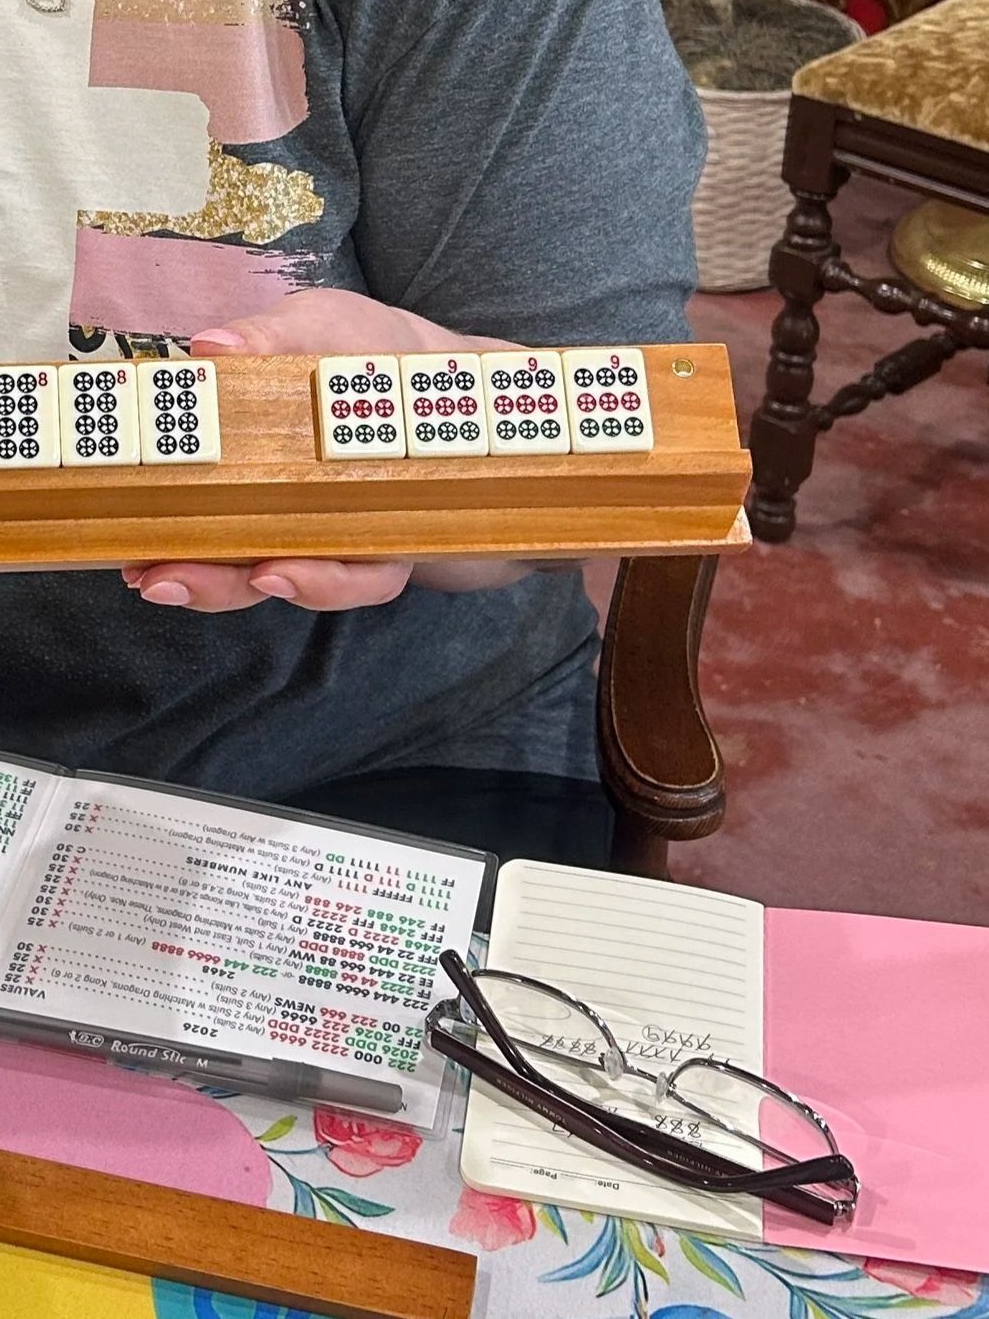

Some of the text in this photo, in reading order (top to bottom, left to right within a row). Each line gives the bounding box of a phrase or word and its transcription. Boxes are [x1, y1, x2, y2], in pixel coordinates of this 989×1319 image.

[365, 361, 375, 376] 9
[447, 359, 458, 374] 9
[528, 357, 538, 372] 9
[610, 355, 620, 370] 9
[38, 372, 48, 386] 8
[117, 370, 127, 384] 8
[196, 368, 206, 382] 8
[63, 821, 82, 832] 30
[55, 841, 74, 853] 30
[184, 855, 312, 890] ANY LIKE NUMBERS
[336, 879, 368, 893] 1111
[303, 894, 330, 908] 888
[371, 886, 413, 903] FFFFFF
[334, 901, 362, 915] 246
[417, 896, 449, 911] 1111
[25, 915, 44, 927] 25
[366, 908, 394, 922] 888
[397, 914, 426, 928] 246
[95, 928, 103, 936] 2
[104, 929, 115, 937] or
[429, 922, 445, 932] FF
[15, 940, 34, 952] 30
[124, 933, 147, 945] (Any
[149, 940, 185, 956] 8888
[11, 950, 30, 962] 25
[185, 948, 221, 965] 6666
[7, 961, 26, 972] 25
[222, 957, 249, 971] 444
[251, 964, 278, 977] 222
[3, 971, 21, 983] 25
[50, 967, 62, 977] 6)
[62, 971, 73, 979] or
[200, 964, 235, 979] 2468
[81, 973, 108, 987] Kong
[297, 974, 332, 990] 8888
[107, 979, 151, 997] Dragons,
[240, 988, 247, 996] 2
[334, 982, 370, 998] 6666
[151, 989, 196, 1007] Matching
[248, 989, 272, 1002] (Any
[372, 991, 399, 1004] 444
[245, 1001, 253, 1009] 3
[253, 1001, 277, 1015] (Any
[273, 996, 315, 1014] NEWS
[401, 997, 428, 1011] 222
[233, 1009, 241, 1018] 2
[241, 1010, 265, 1024] (Any
[279, 1009, 317, 1025] 6666
[318, 1006, 347, 1021] 666
[350, 1013, 378, 1028] 222
[181, 1021, 218, 1038] 2026
[236, 1021, 243, 1030] 2
[242, 1022, 266, 1035] (Any
[266, 1017, 300, 1033] DDD
[321, 1018, 350, 1033] 222
[404, 1026, 423, 1038] 22
[268, 1029, 307, 1047] 6666
[302, 1025, 340, 1042] 2222
[353, 1026, 393, 1043] 2026
[310, 1039, 349, 1057] 2222
[344, 1035, 377, 1051] DDD
[396, 1036, 421, 1049] FFF
[77, 1033, 103, 1046] BIC
[110, 1040, 158, 1058] Round
[196, 1058, 209, 1068] M
[353, 1049, 383, 1065] 000
[380, 1044, 418, 1061] 2026
[386, 1057, 416, 1072] 222
[532, 1167, 620, 1190] Date: Page:
